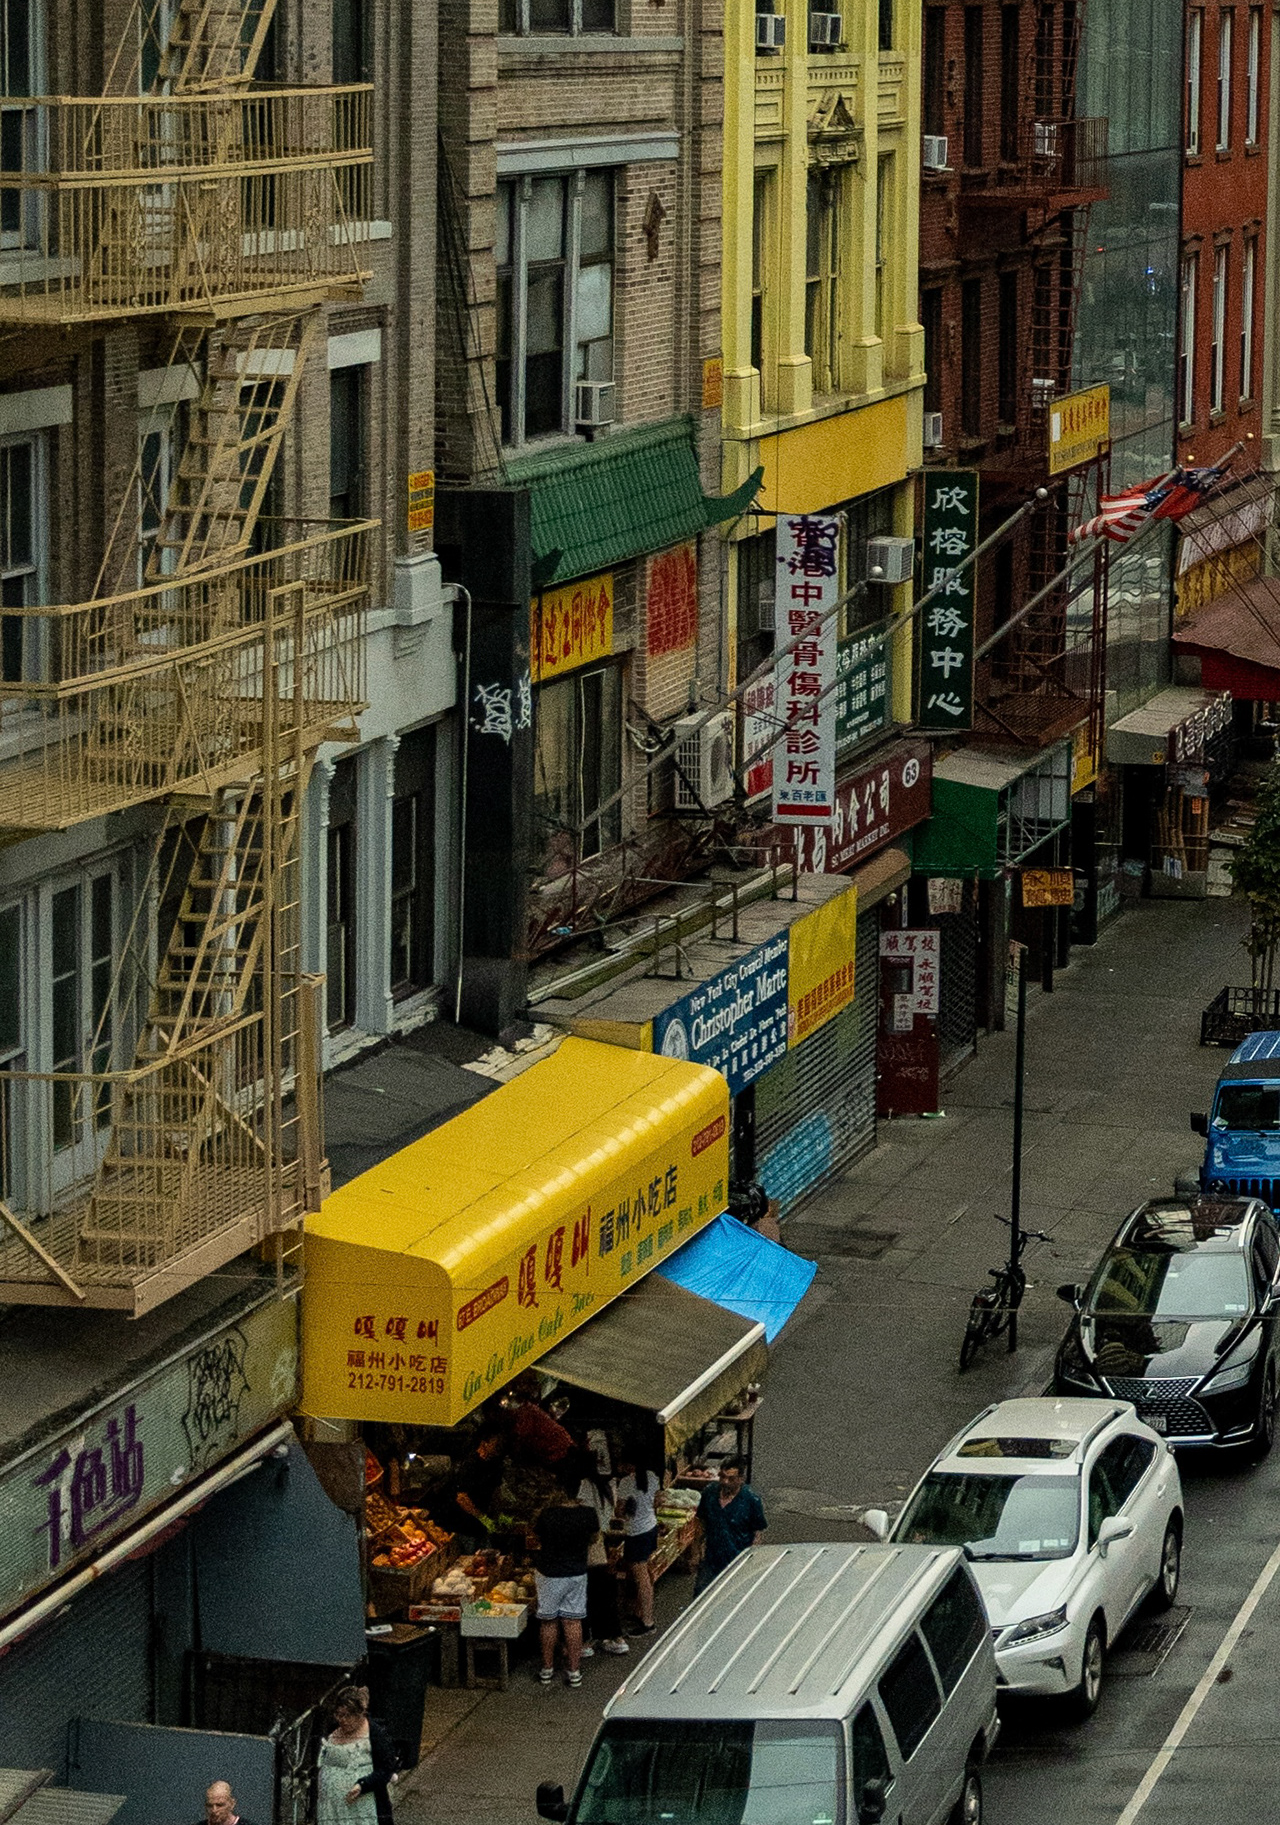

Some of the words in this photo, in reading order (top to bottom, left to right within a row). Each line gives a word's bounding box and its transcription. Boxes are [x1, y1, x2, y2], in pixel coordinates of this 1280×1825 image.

[690, 995, 706, 1017] New
[691, 989, 754, 1051] Christopher
[755, 968, 788, 1007] Marte
[599, 1164, 679, 1258] 福州小吃店
[354, 1315, 440, 1347] 嘎嘎叫
[347, 1349, 448, 1375] 福州小吃店
[347, 1373, 445, 1395] 212-791-2819
